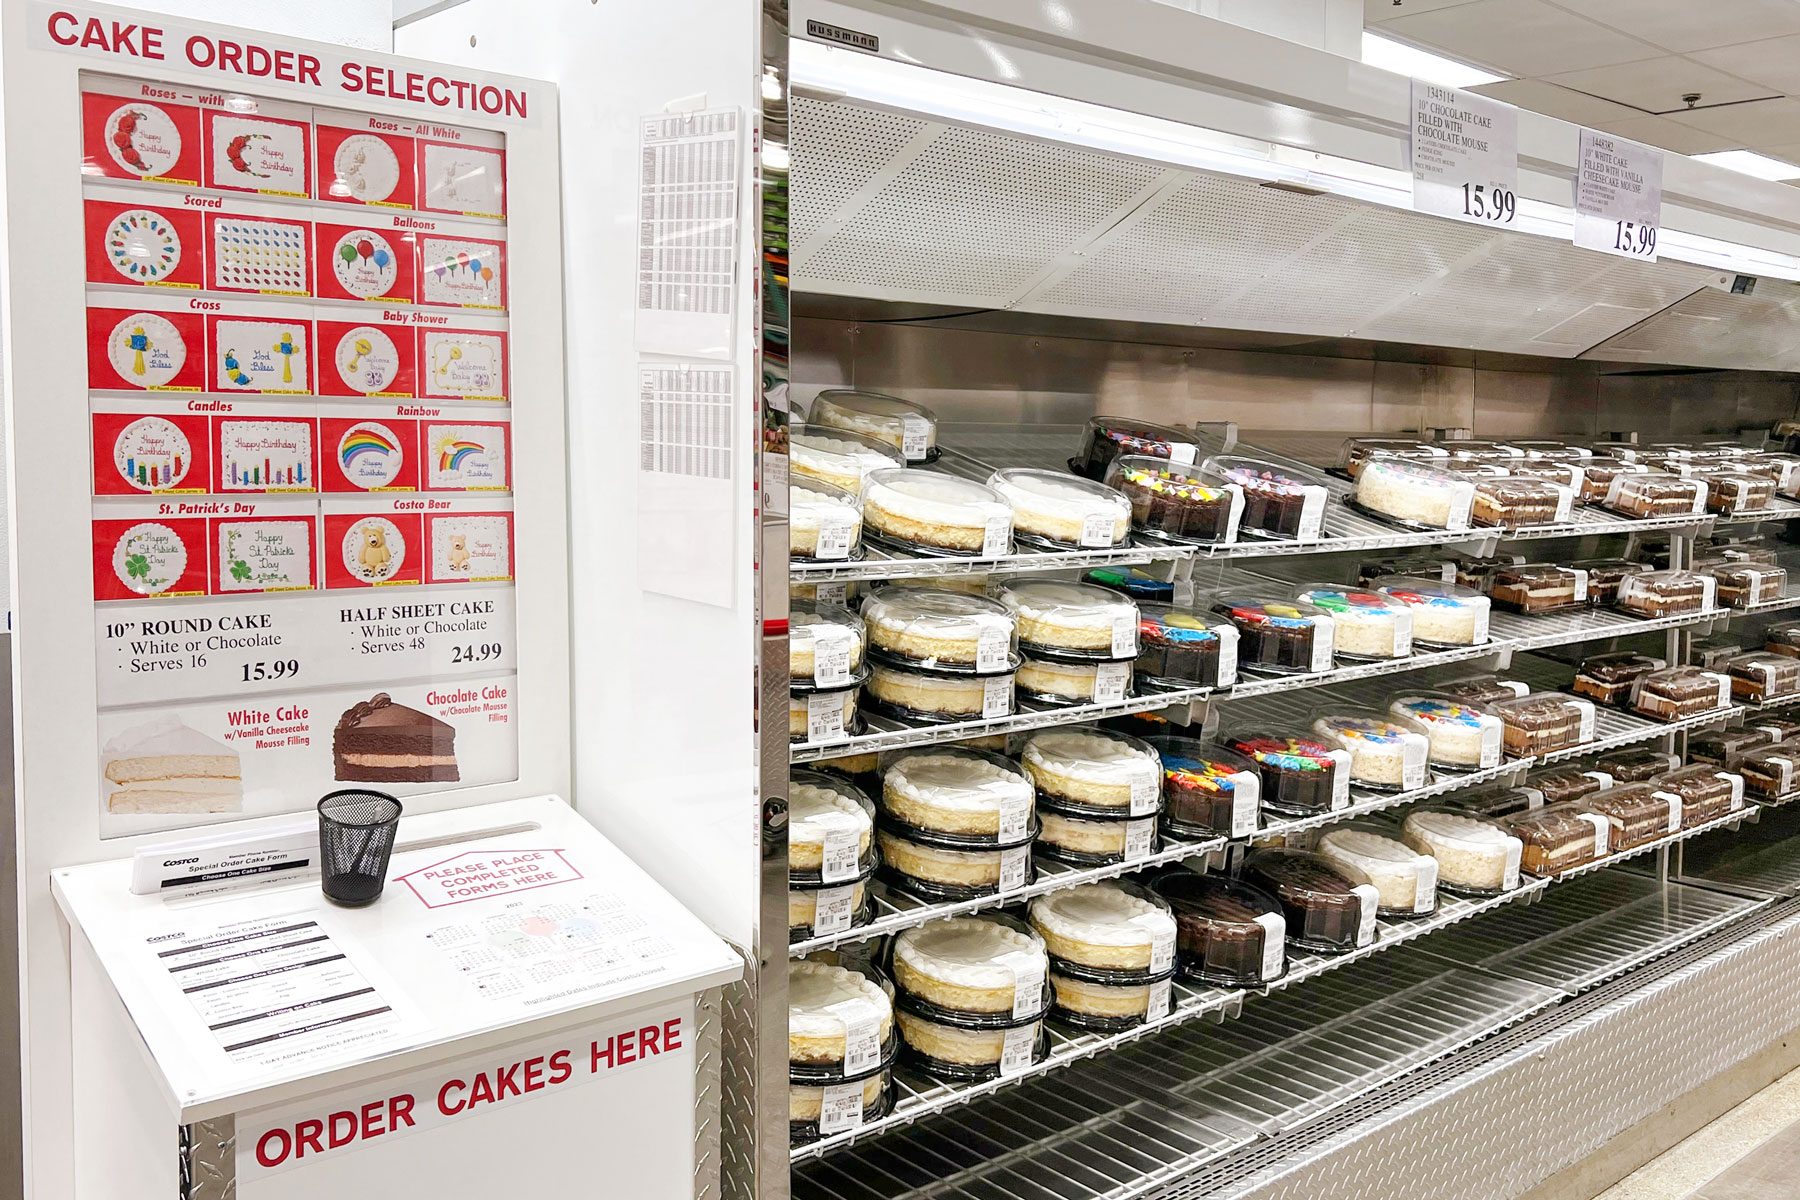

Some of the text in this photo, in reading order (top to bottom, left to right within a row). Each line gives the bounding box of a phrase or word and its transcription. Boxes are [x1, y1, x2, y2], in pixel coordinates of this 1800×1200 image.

[48, 11, 528, 118] CAKE ORDER SELECTION
[142, 85, 176, 99] Roses
[199, 94, 224, 106] with
[1427, 86, 1454, 103] 1343114
[1418, 112, 1462, 133] FILLED WITH
[1430, 102, 1472, 123] CHOCOLATE
[1473, 114, 1492, 128] CAKE
[139, 130, 161, 143] Happy
[369, 118, 461, 139] Roses All White
[1418, 125, 1460, 145] CHOCOLATE
[1462, 136, 1488, 152] MOUSSE
[139, 142, 171, 158] Birthday
[260, 145, 284, 160] Happy
[261, 160, 294, 174] Birthday
[1594, 150, 1612, 164] WHITE
[1613, 157, 1628, 168] CAKE
[1584, 159, 1643, 184] FILLED WITH VANILLA
[1584, 171, 1619, 187] CHEESECAKE
[1620, 181, 1642, 194] MOUSSE
[184, 195, 222, 208] Scored
[1462, 182, 1515, 222] 15.99
[394, 216, 435, 230] Balloons
[1614, 220, 1656, 256] 15.99
[190, 299, 221, 310] Cross
[383, 311, 448, 324] Baby Shower
[152, 348, 169, 359] God
[253, 350, 271, 360] God
[150, 360, 172, 369] Bless
[251, 361, 274, 372] Bless
[188, 400, 232, 412] Candles
[397, 406, 440, 416] Rainbow
[141, 434, 165, 446] Happy
[235, 437, 297, 453] Happy Birthday
[137, 447, 171, 459] Birthday
[158, 504, 173, 515] St.
[234, 504, 255, 516] Day
[394, 500, 451, 509] Costco Bear
[143, 532, 169, 544] Happy
[254, 530, 284, 544] Happy
[148, 556, 166, 567] Day
[259, 558, 280, 571] Day
[340, 601, 494, 623] HALF SHEET CAKE
[141, 618, 212, 636] ROUND
[219, 614, 272, 631] CAKE
[361, 619, 487, 638] White or Chocolate
[130, 634, 282, 655] White or Chocolate
[361, 637, 425, 654] Serves 48
[452, 643, 502, 663] 24.99
[130, 655, 207, 673] Serves 16
[242, 659, 299, 682] 15.99
[427, 685, 507, 706] Chocolate Cake
[228, 705, 309, 726] White Cake
[440, 702, 507, 717] w/Chocolate Mousse
[489, 714, 507, 722] Filling
[224, 723, 309, 741] w/Vanilla Cheesecake
[256, 736, 310, 749] Mousse Filling
[188, 862, 218, 873] Special
[221, 859, 243, 868] Order
[246, 856, 265, 864] Cake
[424, 852, 544, 880] PLEASE PLACE
[202, 872, 226, 881] Choose
[440, 863, 540, 888] COMPLETED
[446, 871, 558, 898] FORMS HERE
[181, 935, 213, 945] Special
[216, 929, 240, 939] Order
[306, 1019, 342, 1032] Information
[256, 1017, 682, 1168] ORDER CAKES HERE
